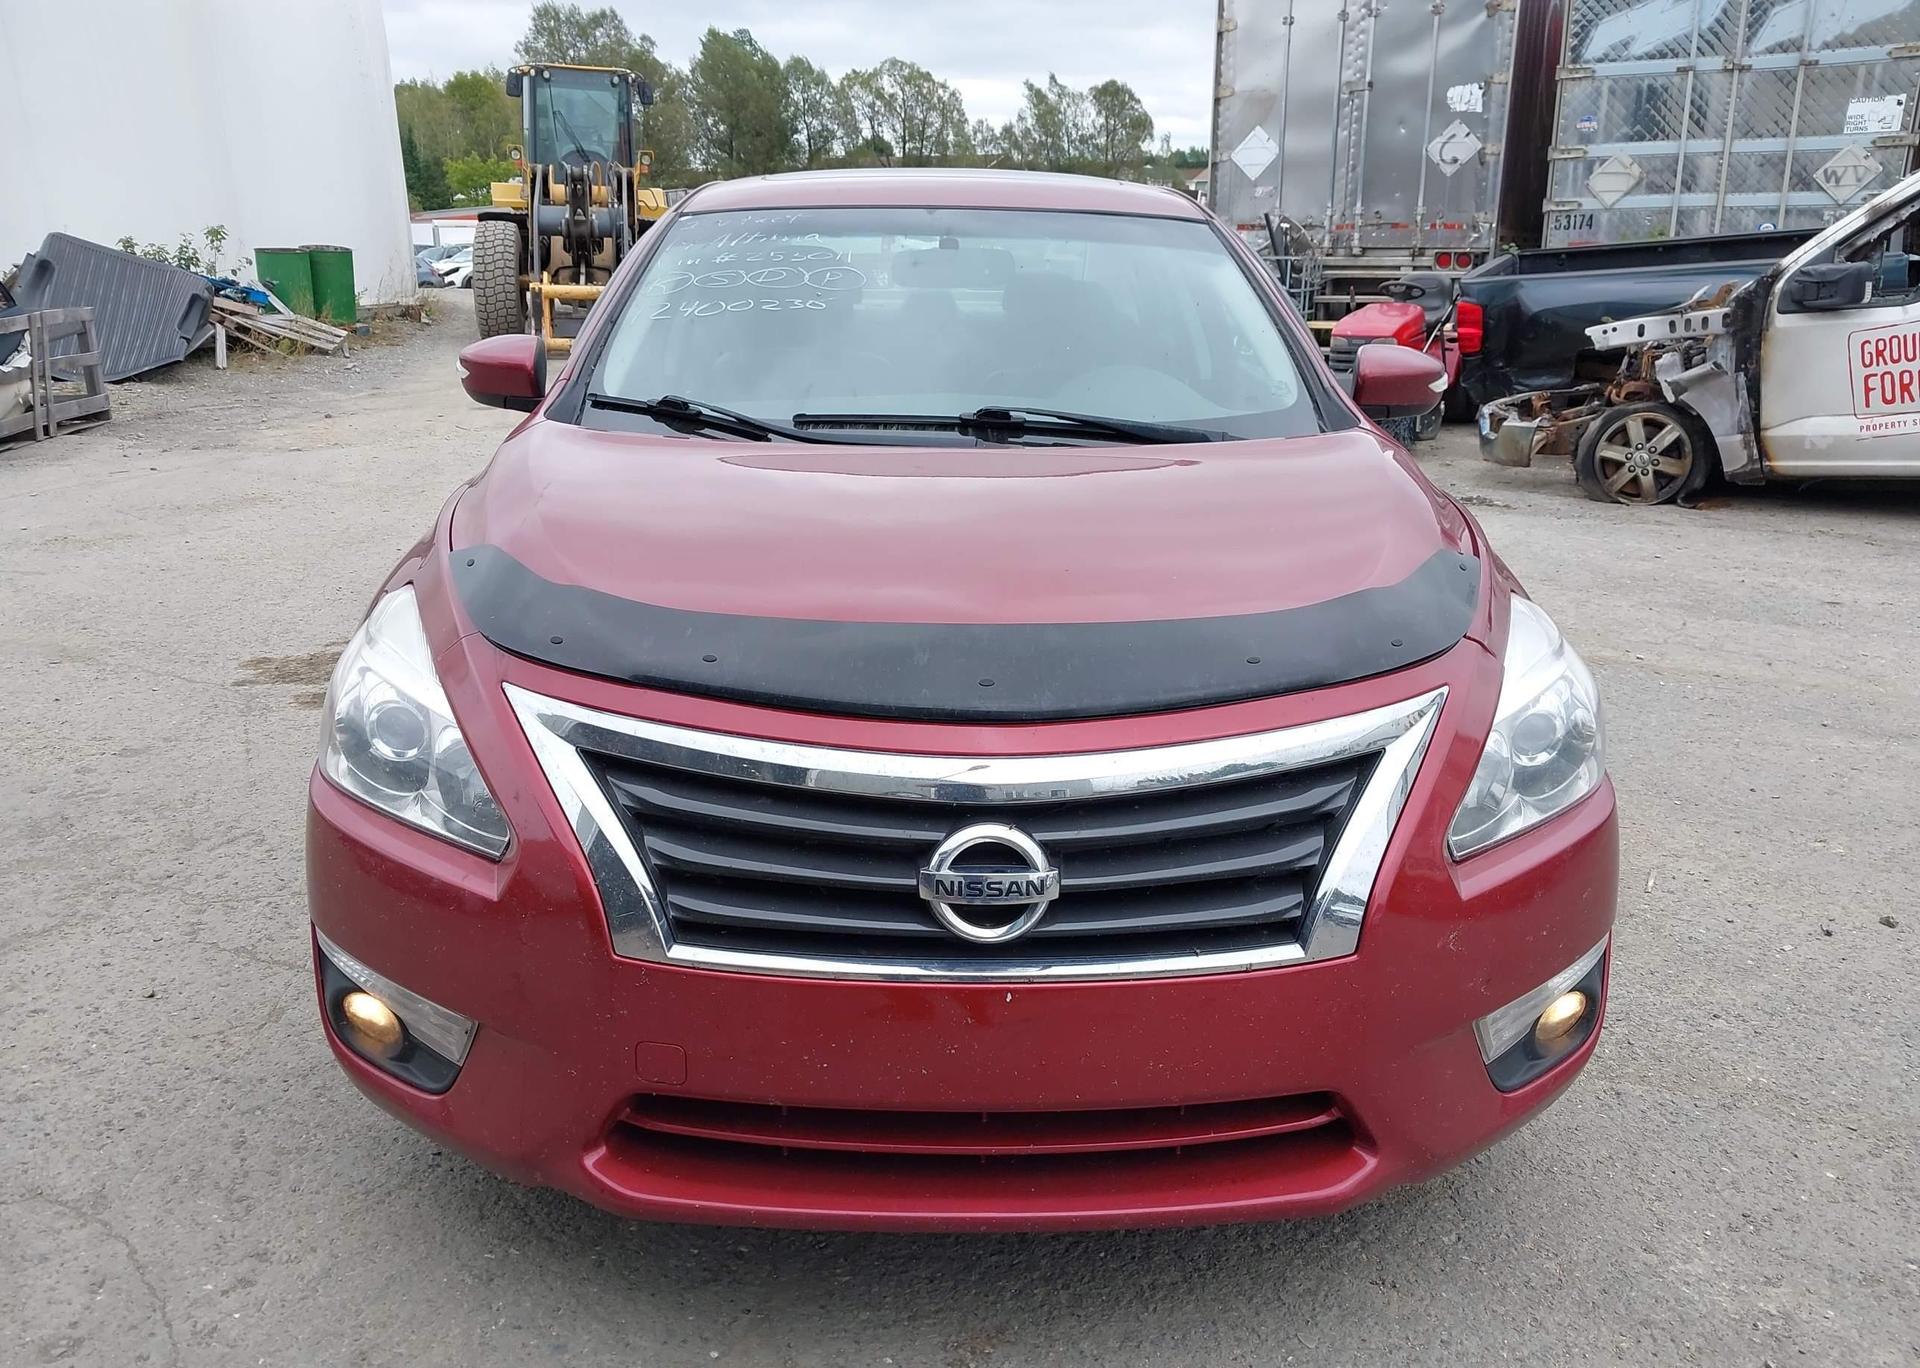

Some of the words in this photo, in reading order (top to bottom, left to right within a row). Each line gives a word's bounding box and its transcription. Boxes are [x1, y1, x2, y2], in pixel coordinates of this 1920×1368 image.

[1850, 96, 1885, 104] CAUTION
[1553, 213, 1595, 231] 53174
[1861, 332, 1920, 368] GROU
[1863, 369, 1920, 408] FOR
[1859, 420, 1907, 432] PROPERTY
[935, 879, 1045, 897] NISSAN
